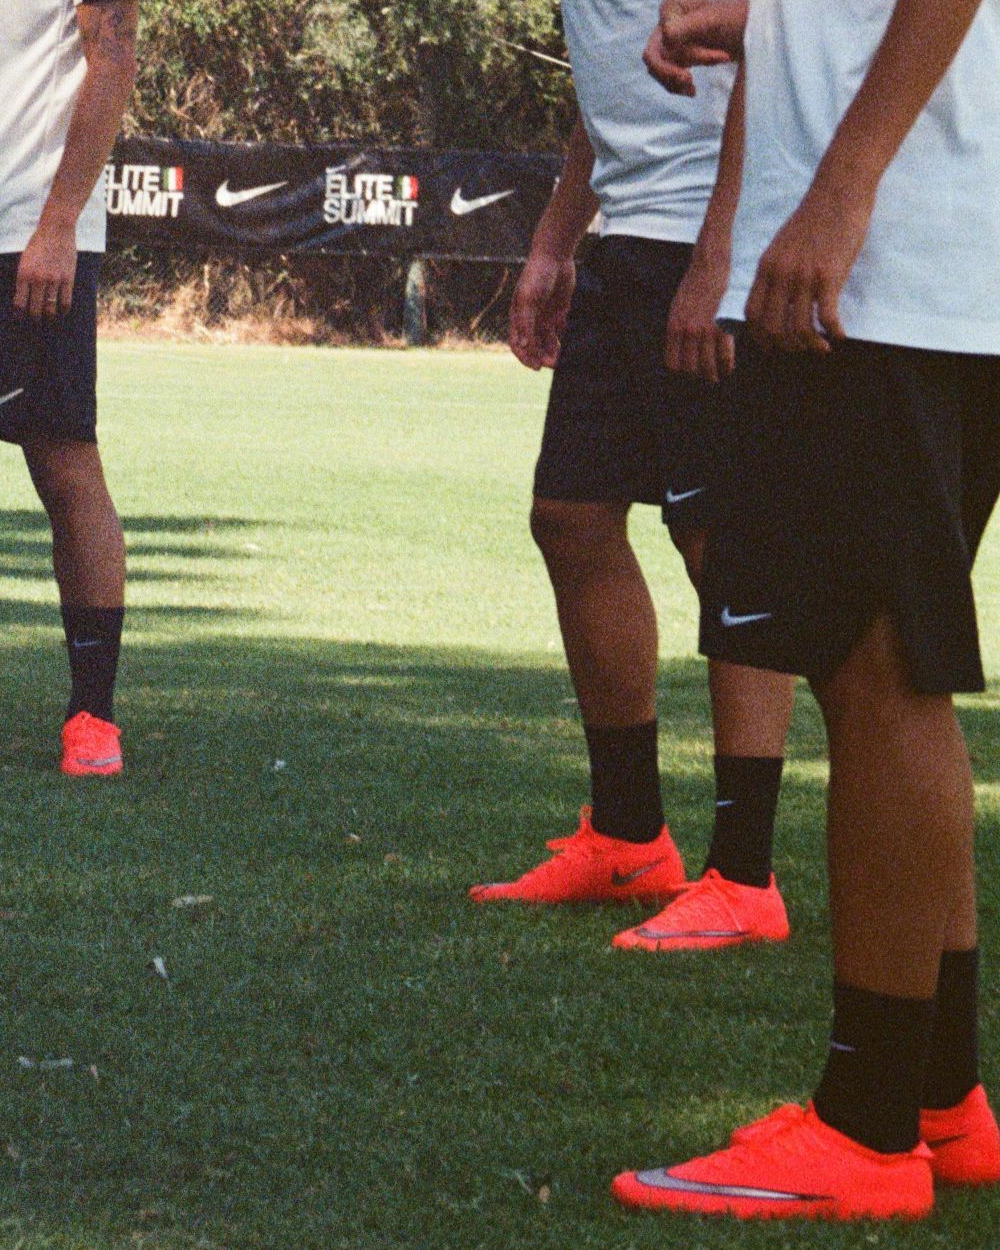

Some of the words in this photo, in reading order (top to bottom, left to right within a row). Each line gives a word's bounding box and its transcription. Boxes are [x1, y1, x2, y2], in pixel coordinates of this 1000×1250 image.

[325, 174, 394, 200] ELITE
[104, 189, 185, 218] UMMIT
[323, 197, 420, 226] SUMMIT
